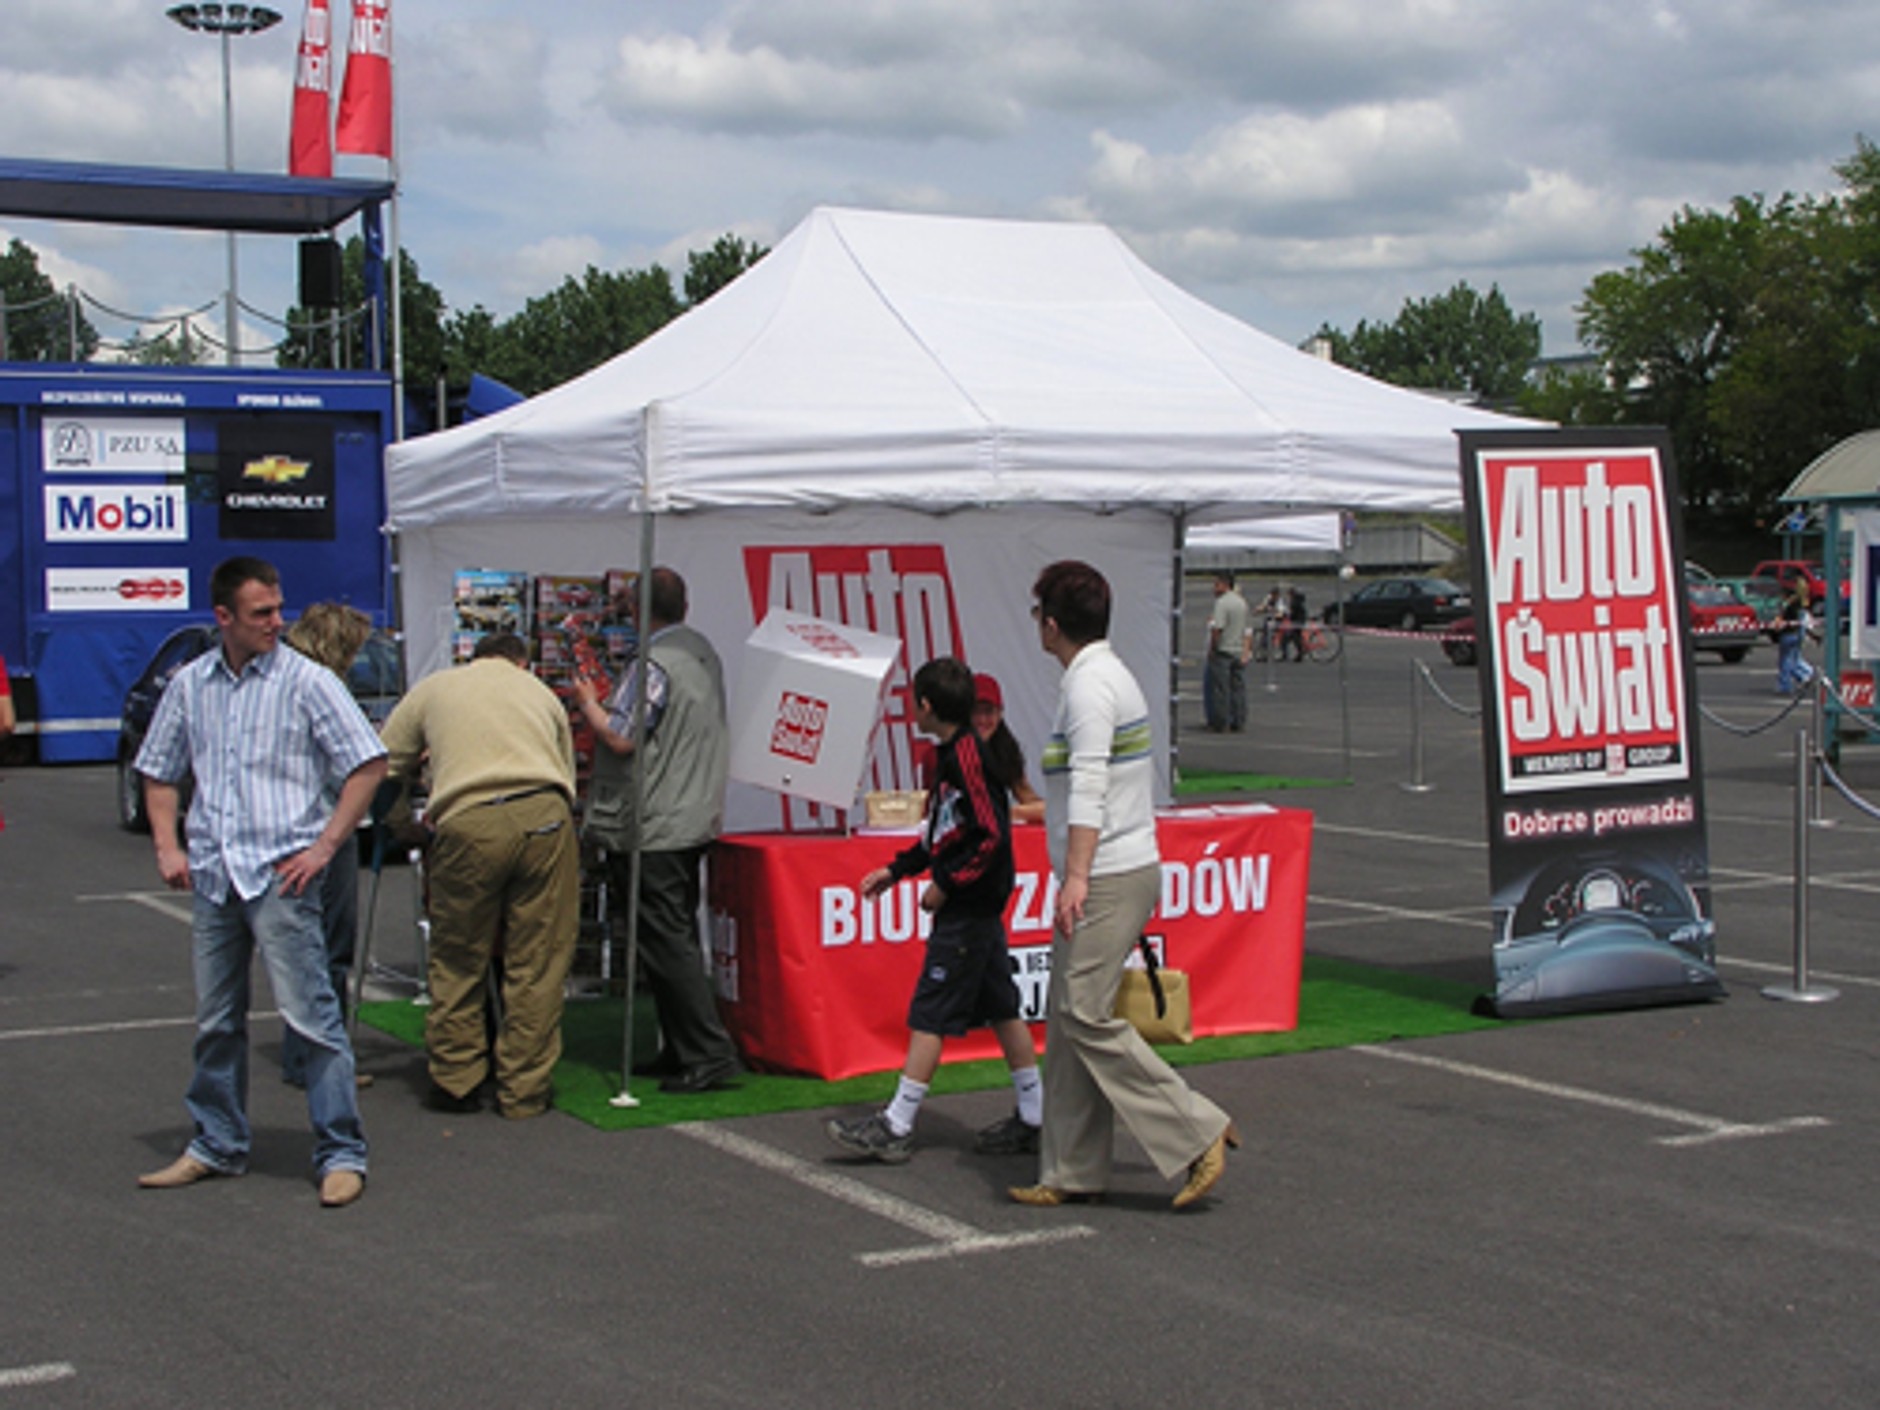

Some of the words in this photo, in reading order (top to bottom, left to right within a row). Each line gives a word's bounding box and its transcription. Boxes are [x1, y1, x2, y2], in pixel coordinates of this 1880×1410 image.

[109, 436, 148, 453] PZU
[57, 496, 174, 531] Mobil
[226, 494, 326, 509] CHEVROLET
[1493, 462, 1656, 604] Auto
[1505, 605, 1675, 742] Świat
[1504, 809, 1588, 837] Dobrze
[1593, 796, 1695, 836] prowadzi
